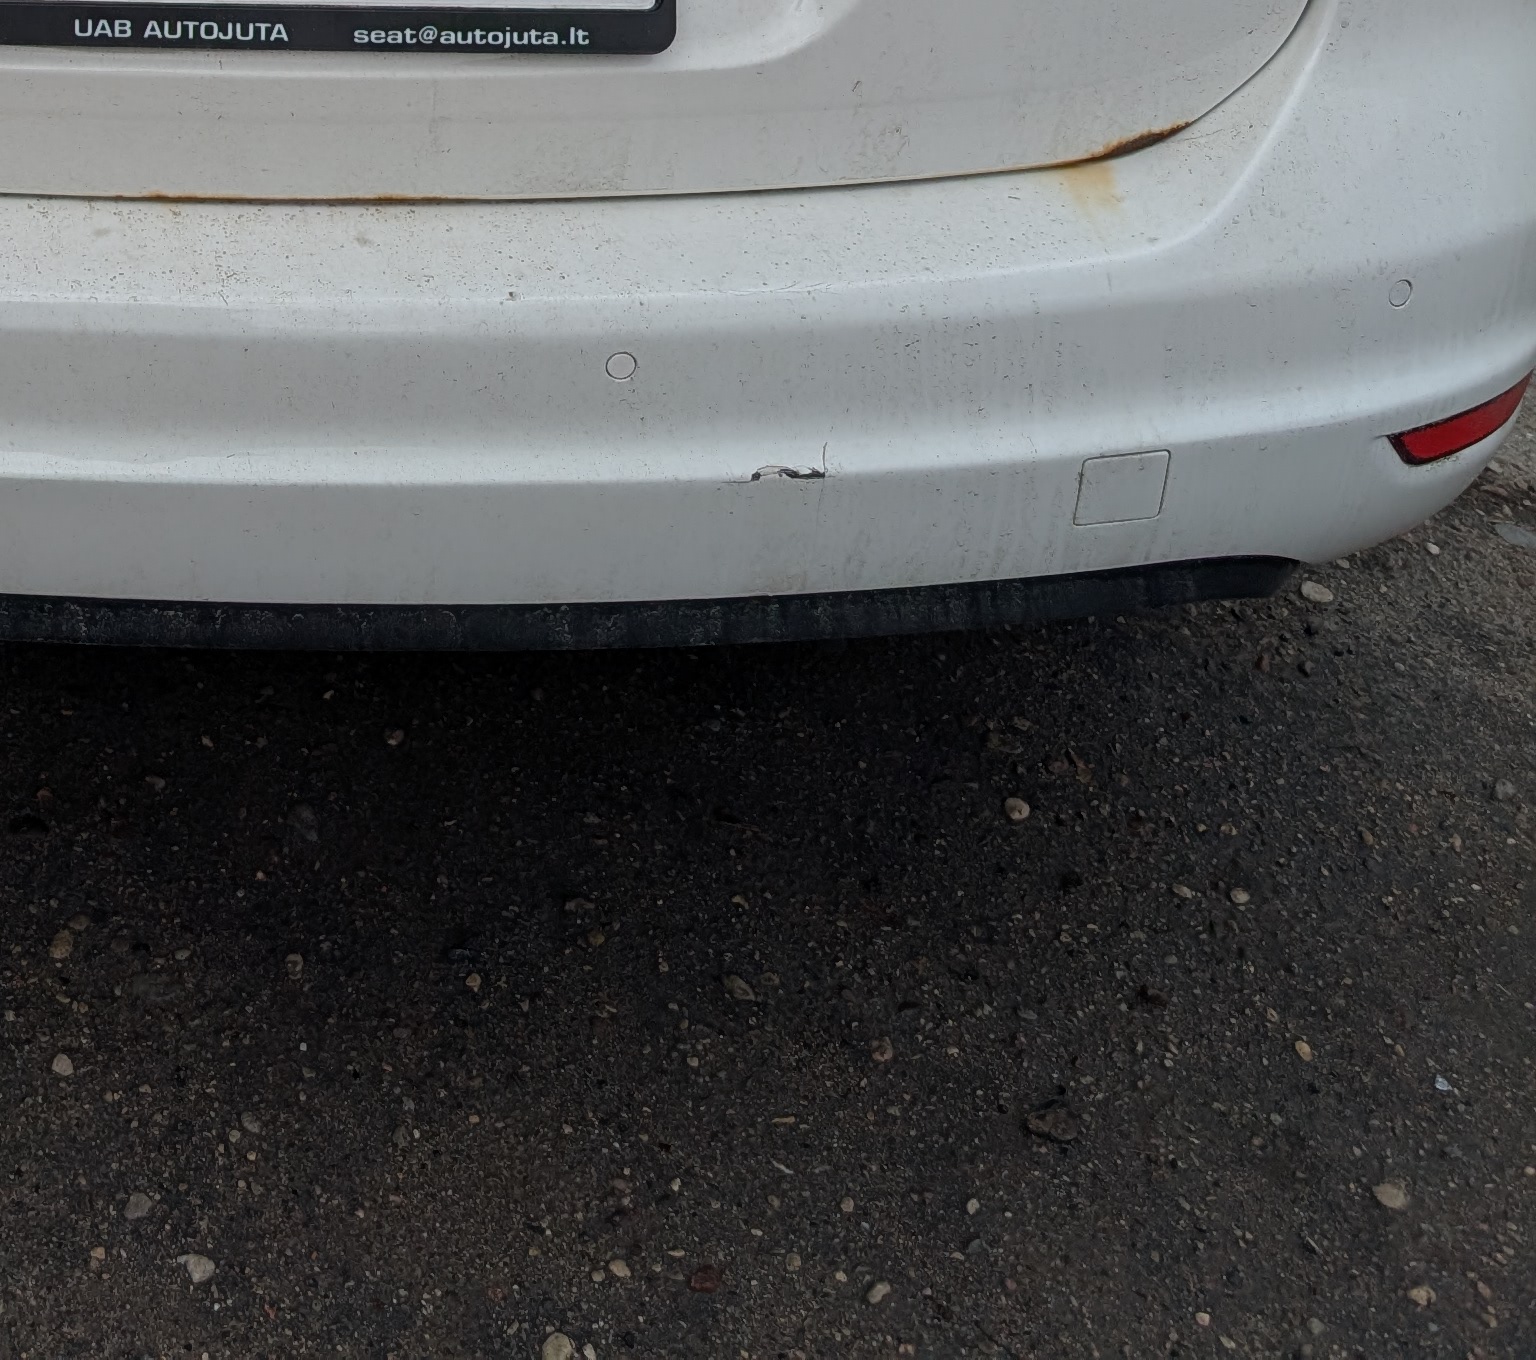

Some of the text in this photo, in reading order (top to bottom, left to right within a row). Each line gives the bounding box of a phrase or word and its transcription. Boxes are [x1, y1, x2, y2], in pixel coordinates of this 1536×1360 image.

[74, 19, 132, 38] UAB
[143, 20, 289, 42] AUTOJUTA
[353, 25, 590, 49] seat@autojuta.lt
